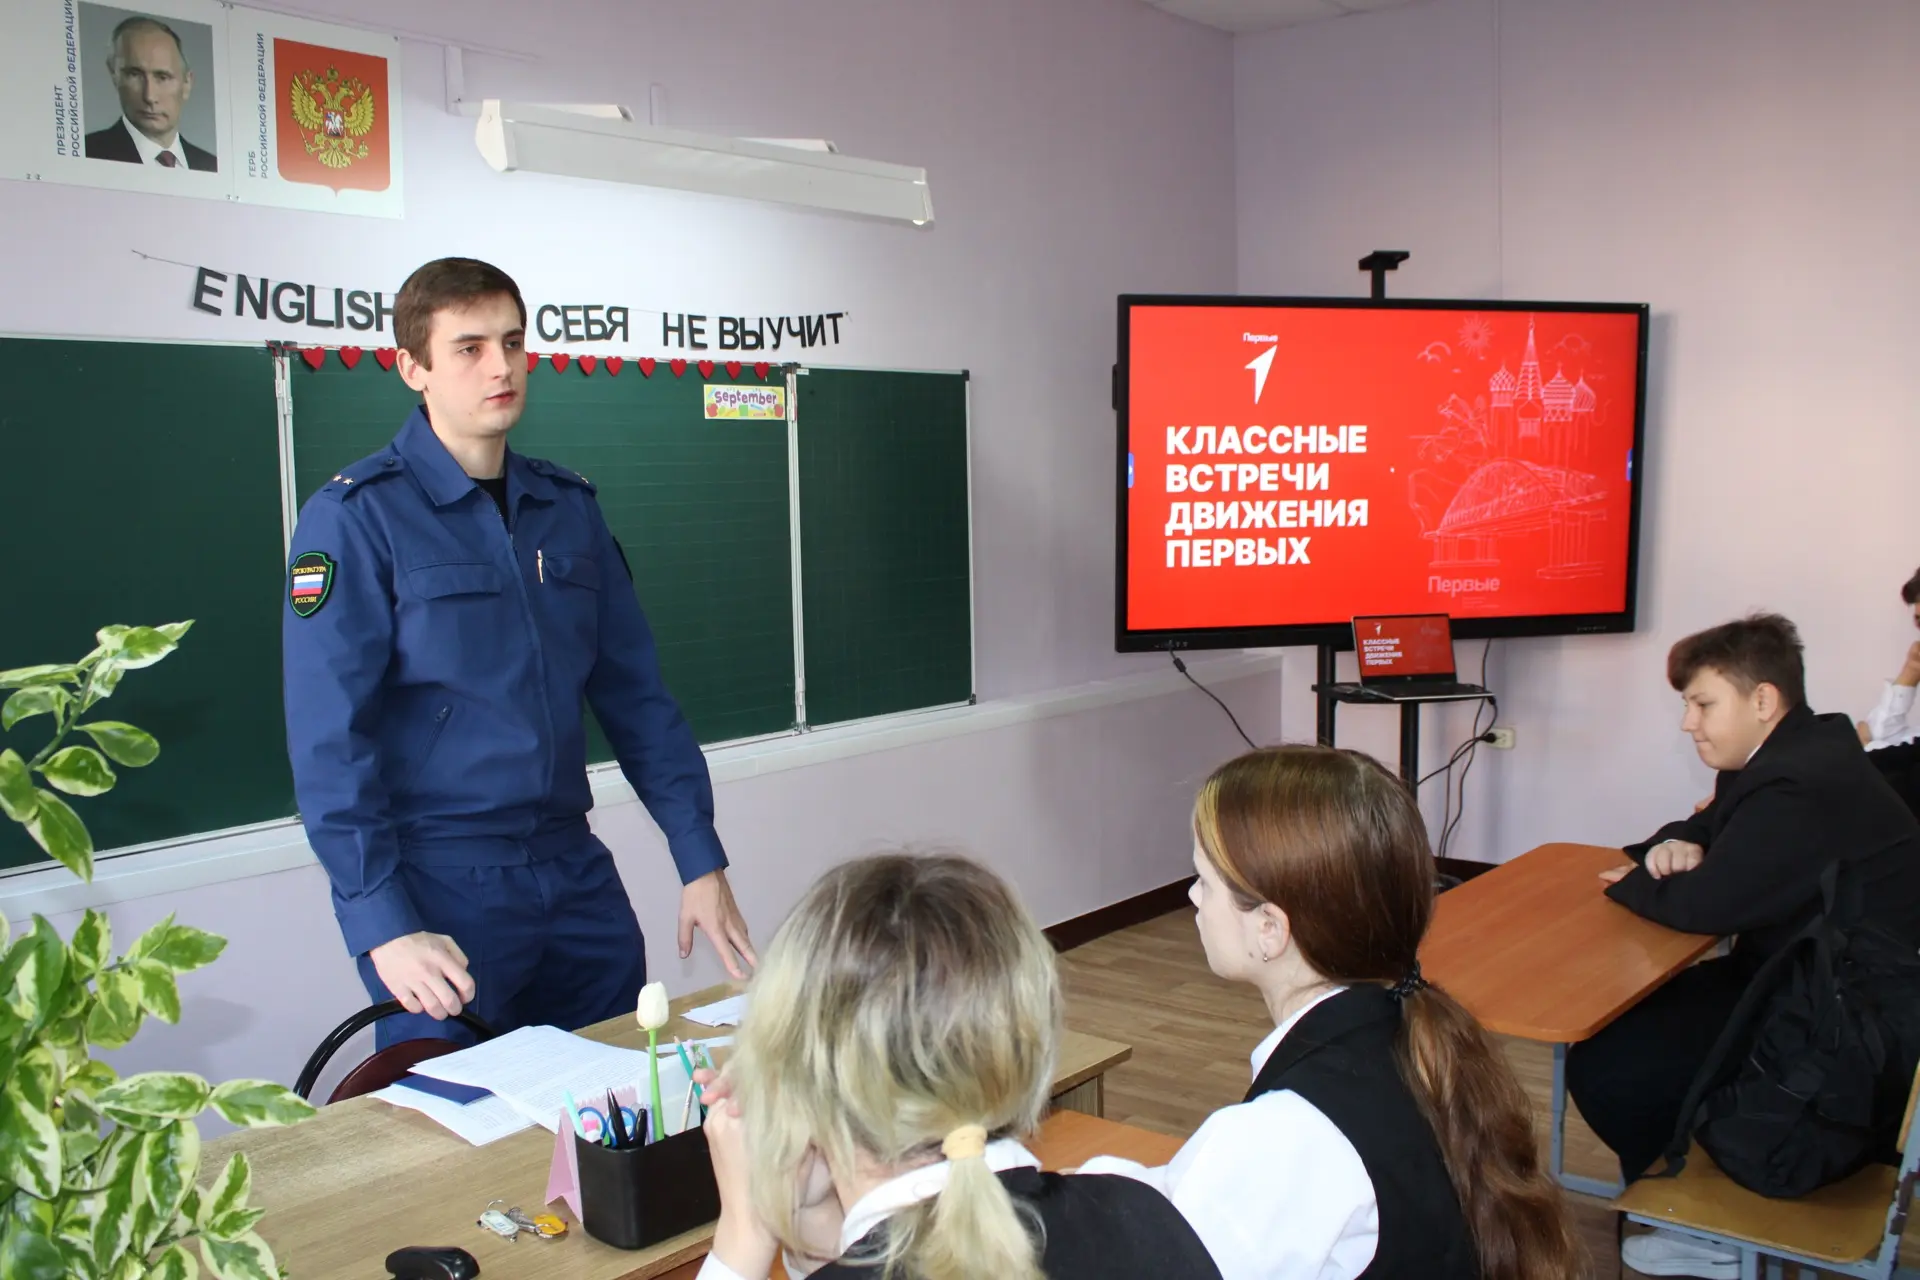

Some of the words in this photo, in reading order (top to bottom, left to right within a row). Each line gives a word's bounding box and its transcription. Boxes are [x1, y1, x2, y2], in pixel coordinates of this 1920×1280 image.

[64, 0, 76, 73] ФЕДЕРАЦИИ
[257, 33, 267, 102] ФЕДЕРАЦИИ
[54, 84, 66, 156] ПРЕЗИДЕНТ
[66, 76, 80, 157] РОССИЙСКОЙ
[258, 104, 268, 179] РОССИЙСКОЙ
[193, 266, 398, 332] ENGLISH
[536, 304, 629, 343] СЕБЯ
[663, 312, 708, 349] НЕ
[718, 313, 844, 350] ВЫУЧИТ
[1166, 425, 1367, 454] КЛАССНЫЕ
[1166, 462, 1329, 492] ВСТРЕЧИ
[1165, 499, 1368, 536] ДВИЖЕНИЯ
[1166, 537, 1311, 567] ПЕРВЫХ
[1428, 576, 1500, 598] Первые
